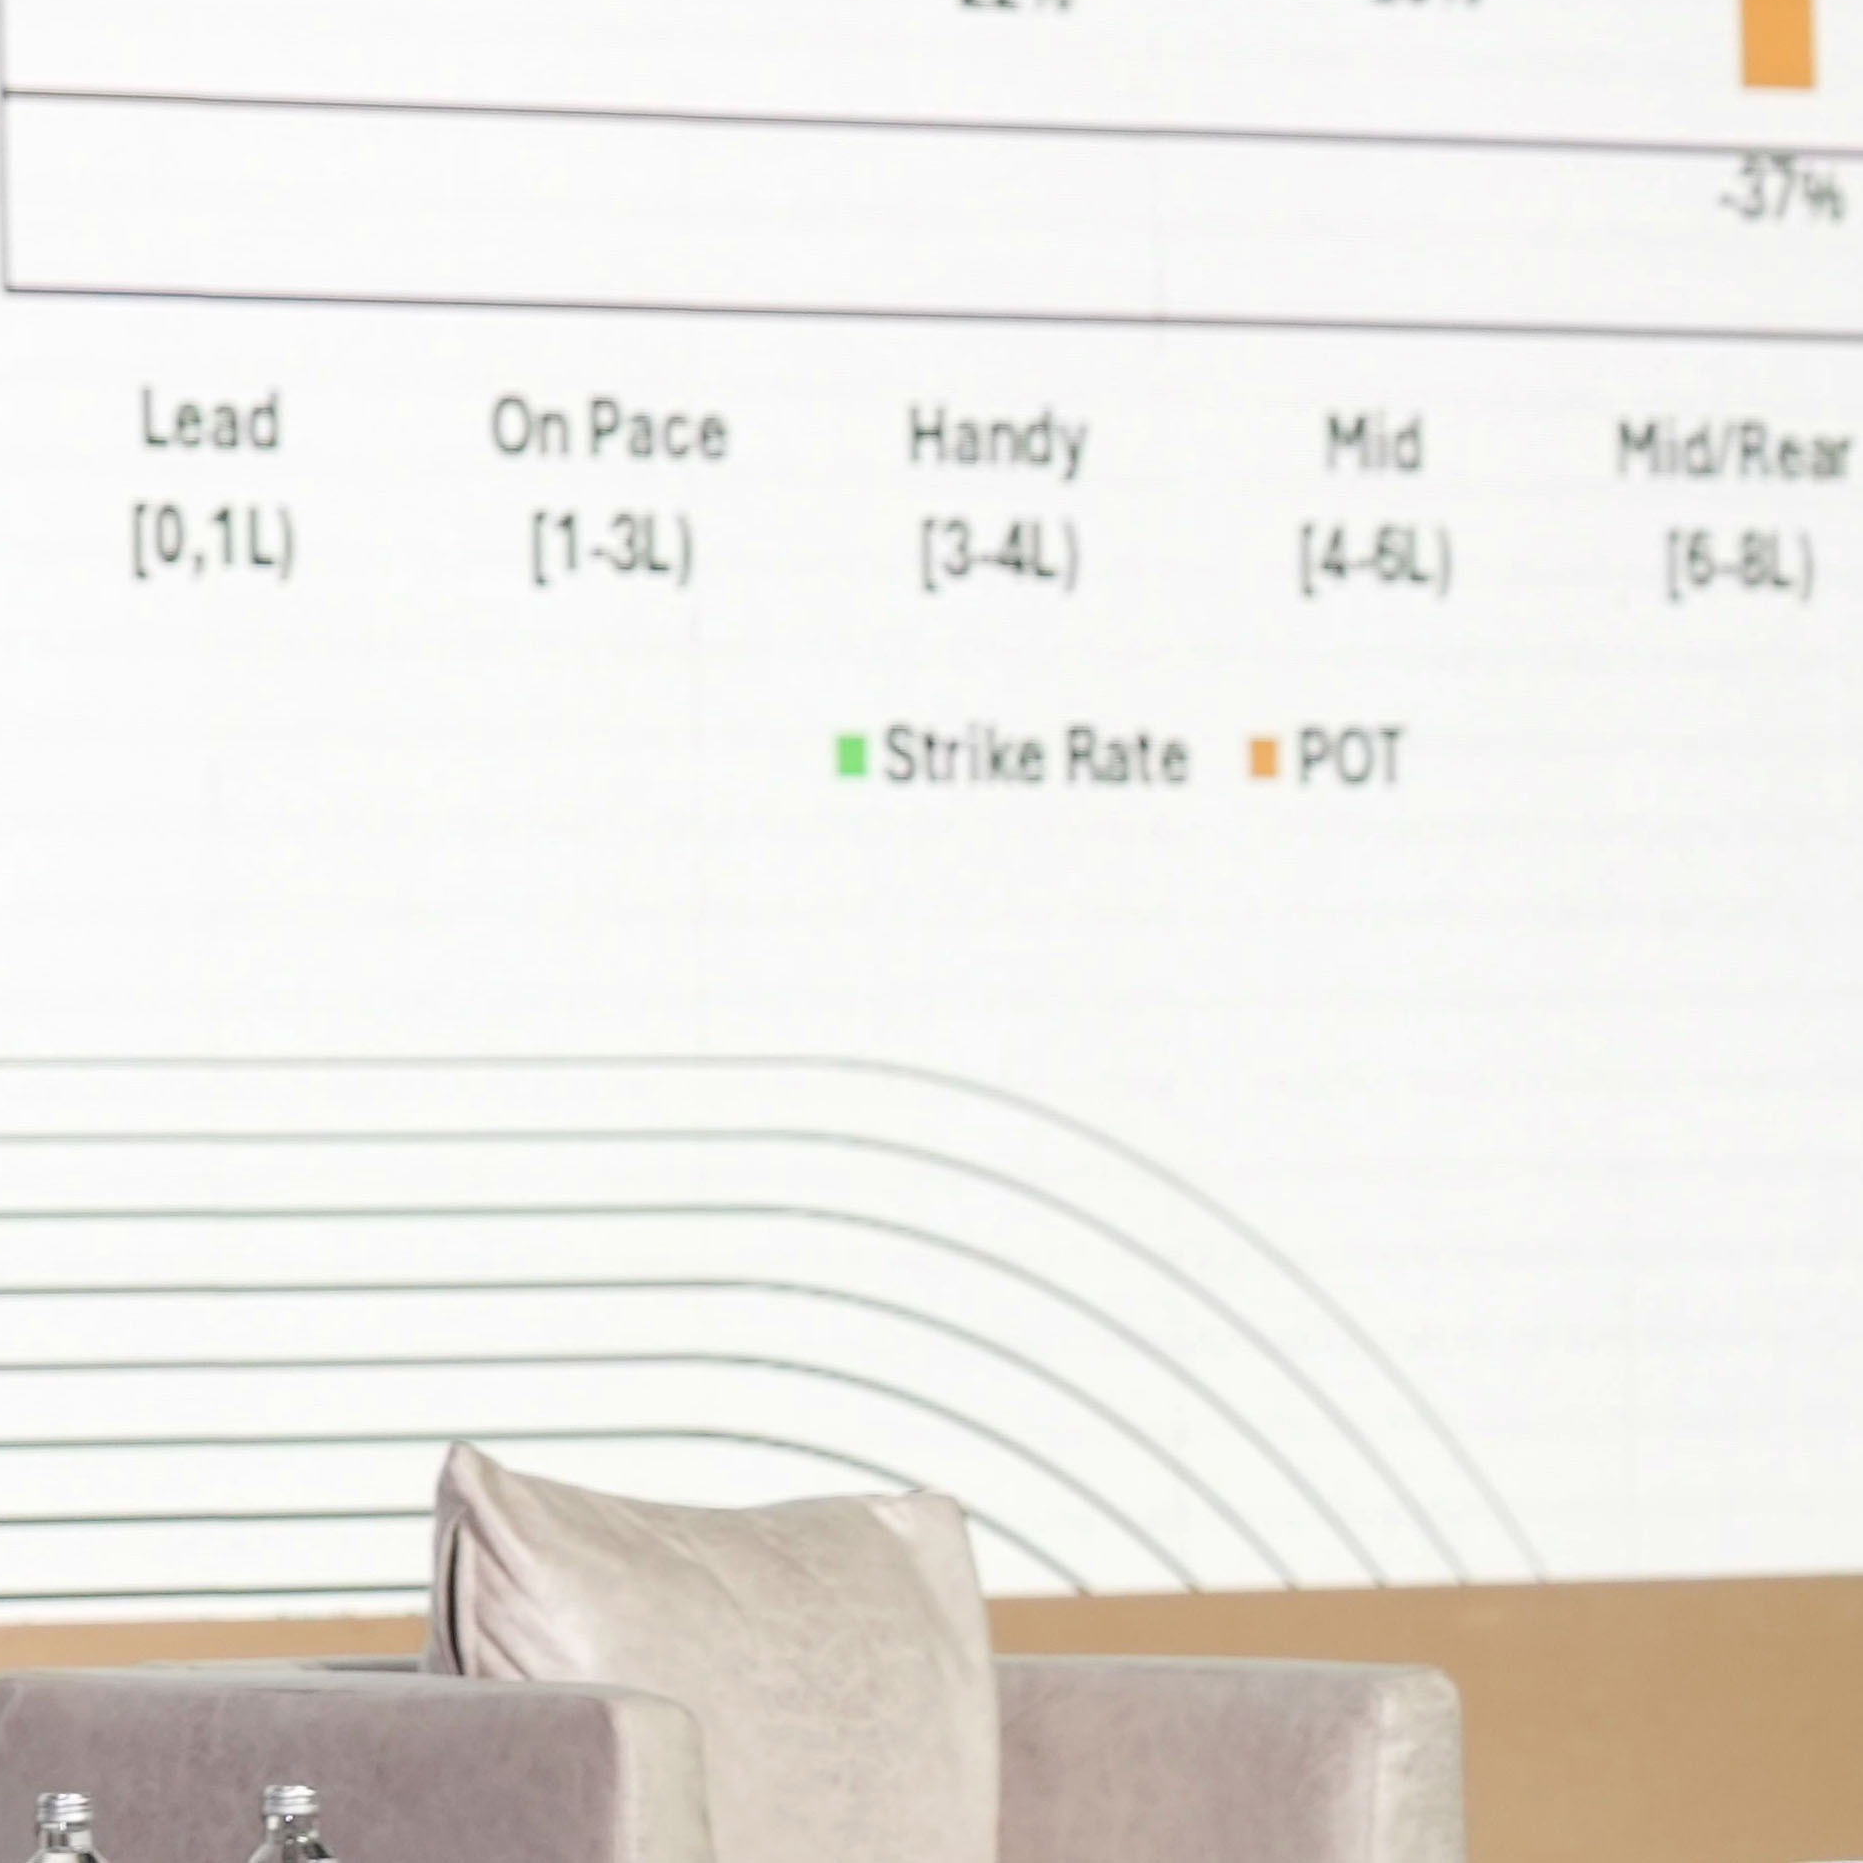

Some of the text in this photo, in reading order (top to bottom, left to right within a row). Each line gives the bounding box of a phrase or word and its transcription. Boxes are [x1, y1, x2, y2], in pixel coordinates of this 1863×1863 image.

[1718, 155, 1844, 222] -37%
[142, 389, 279, 451] Lead
[491, 394, 728, 460] On Pace
[909, 407, 1087, 482] Handy
[1327, 415, 1421, 472] Mid
[1617, 420, 1851, 480] Mid/Rear
[133, 502, 294, 581] [0,1L)
[532, 510, 692, 587] [1-3L)
[922, 518, 1078, 593] [3-4L)
[885, 724, 1189, 785] Strike Rate
[1298, 726, 1403, 786] POT
